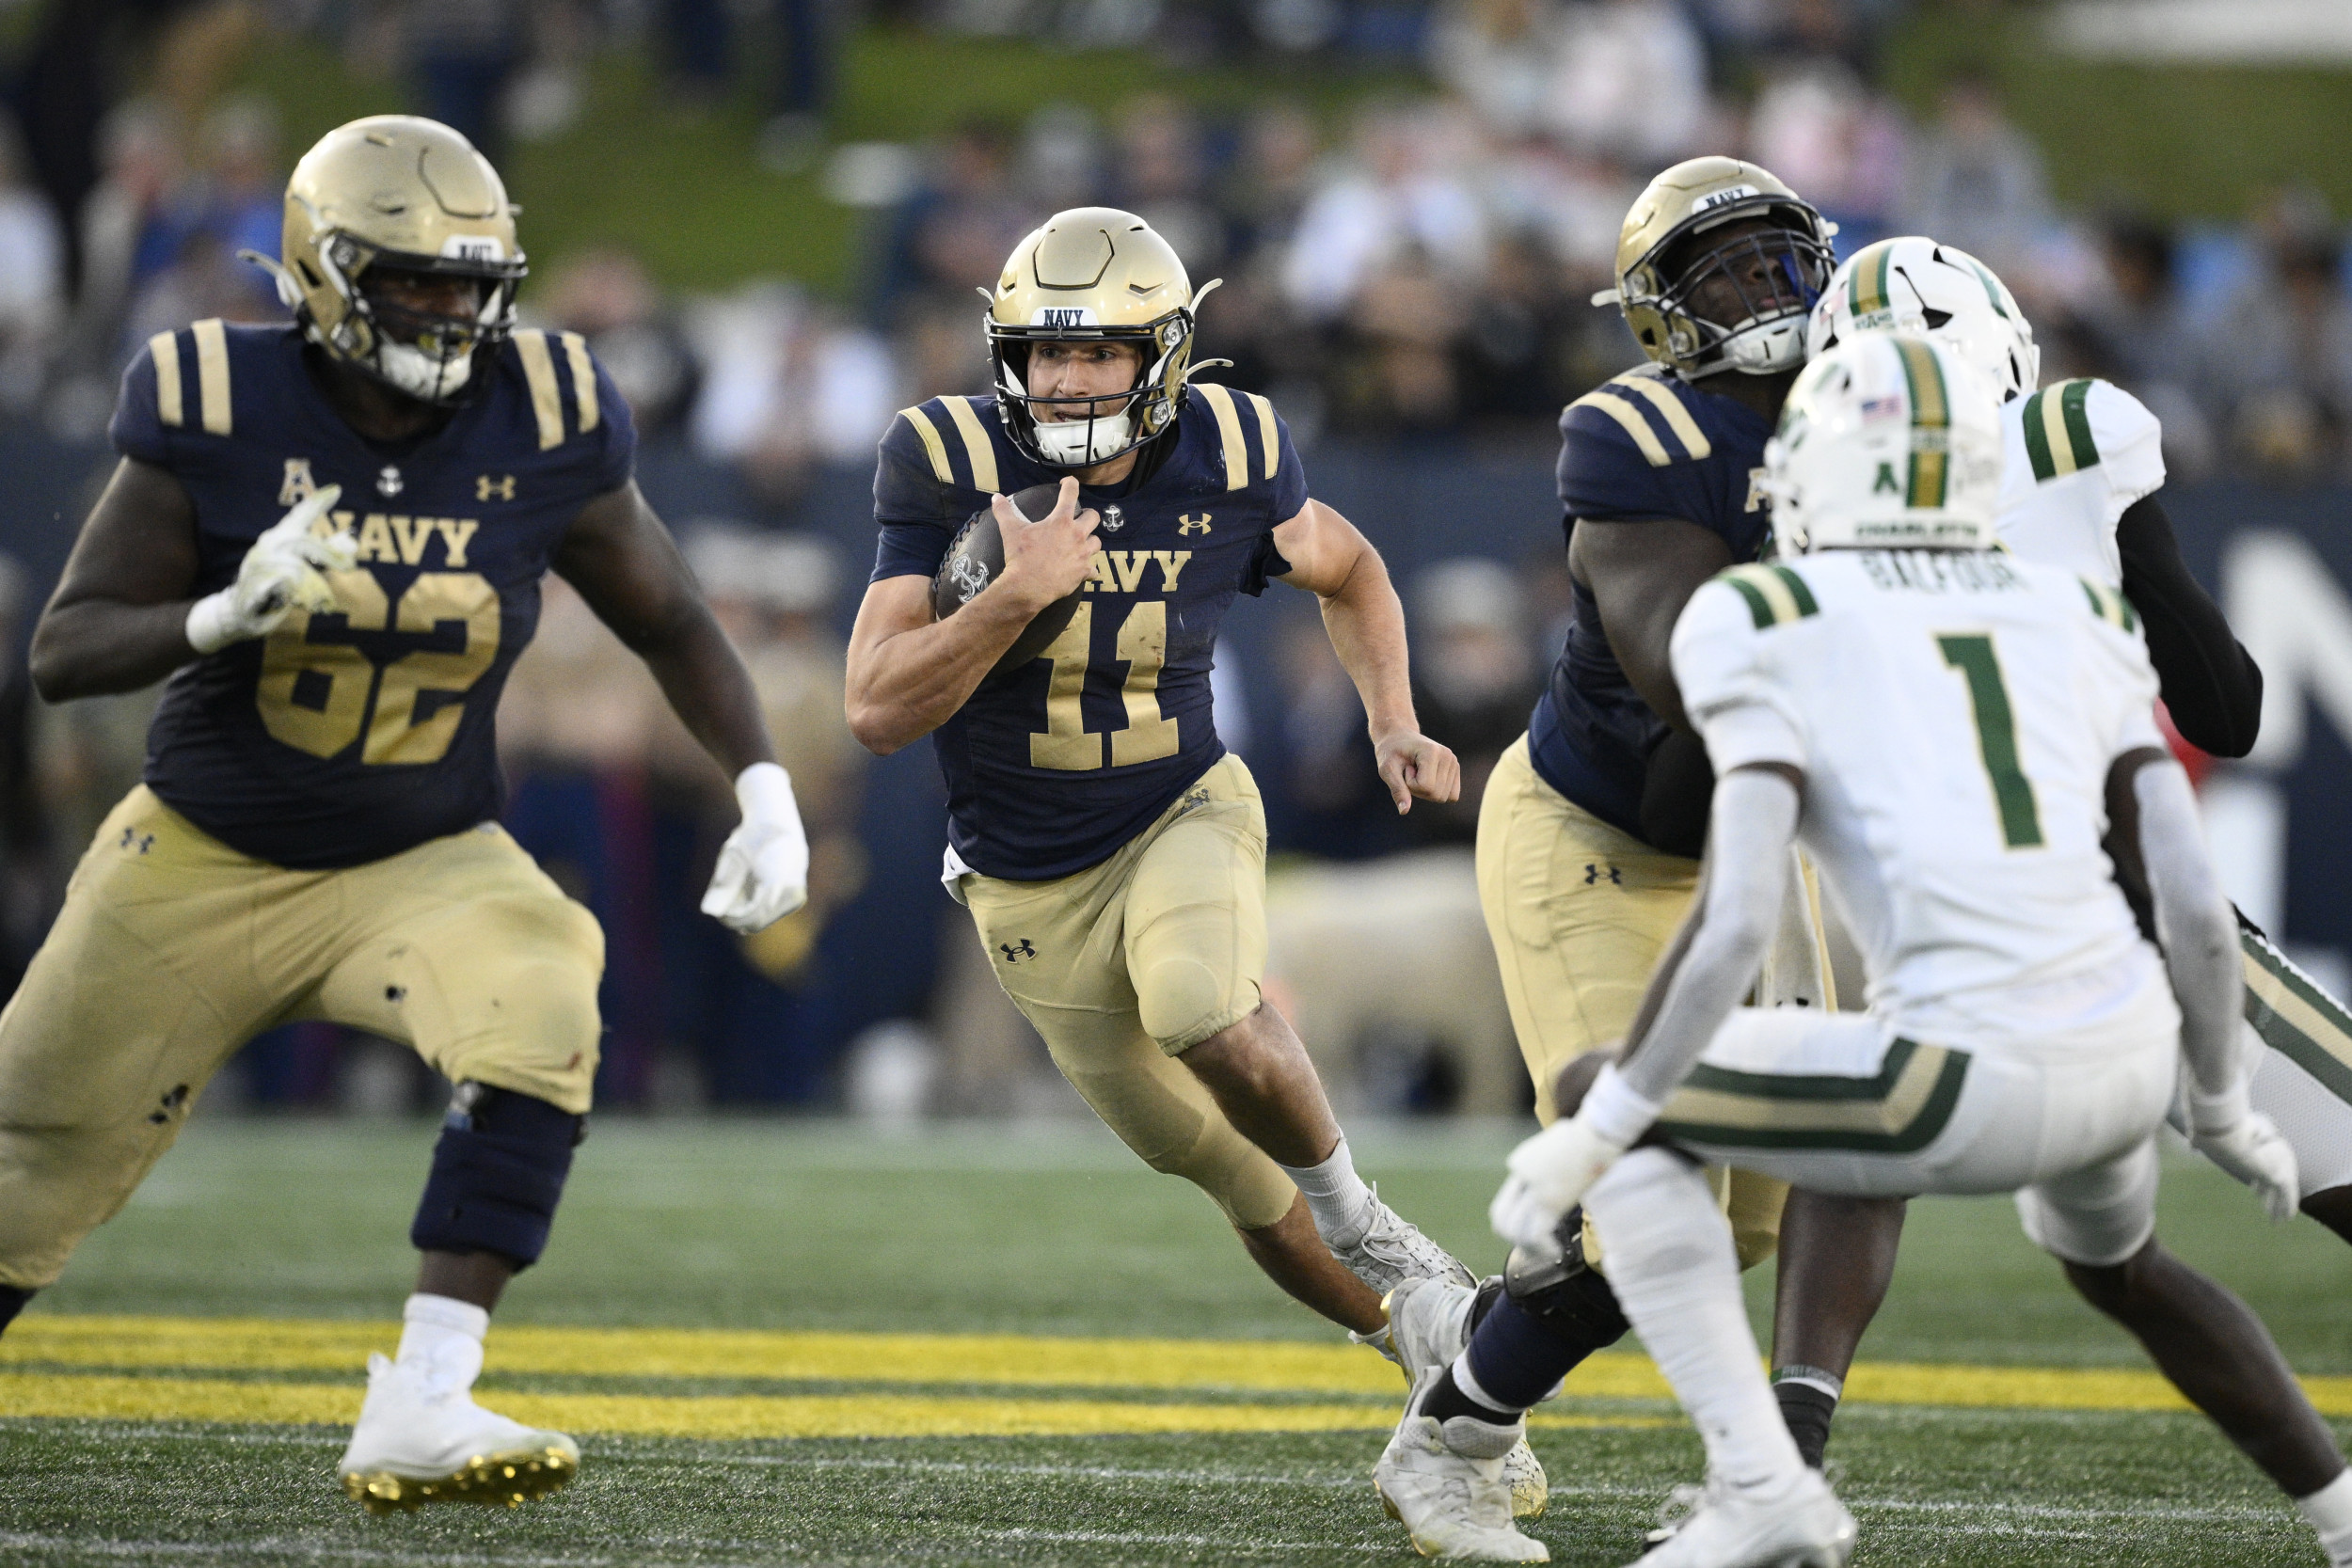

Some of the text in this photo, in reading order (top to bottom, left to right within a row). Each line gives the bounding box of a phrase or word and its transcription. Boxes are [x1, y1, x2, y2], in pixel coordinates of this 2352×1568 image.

[1043, 309, 1083, 326] NAVY
[1083, 550, 1192, 593] AVY
[256, 567, 501, 765] 62
[1030, 601, 1180, 771] 11
[1931, 631, 2049, 852] 1
